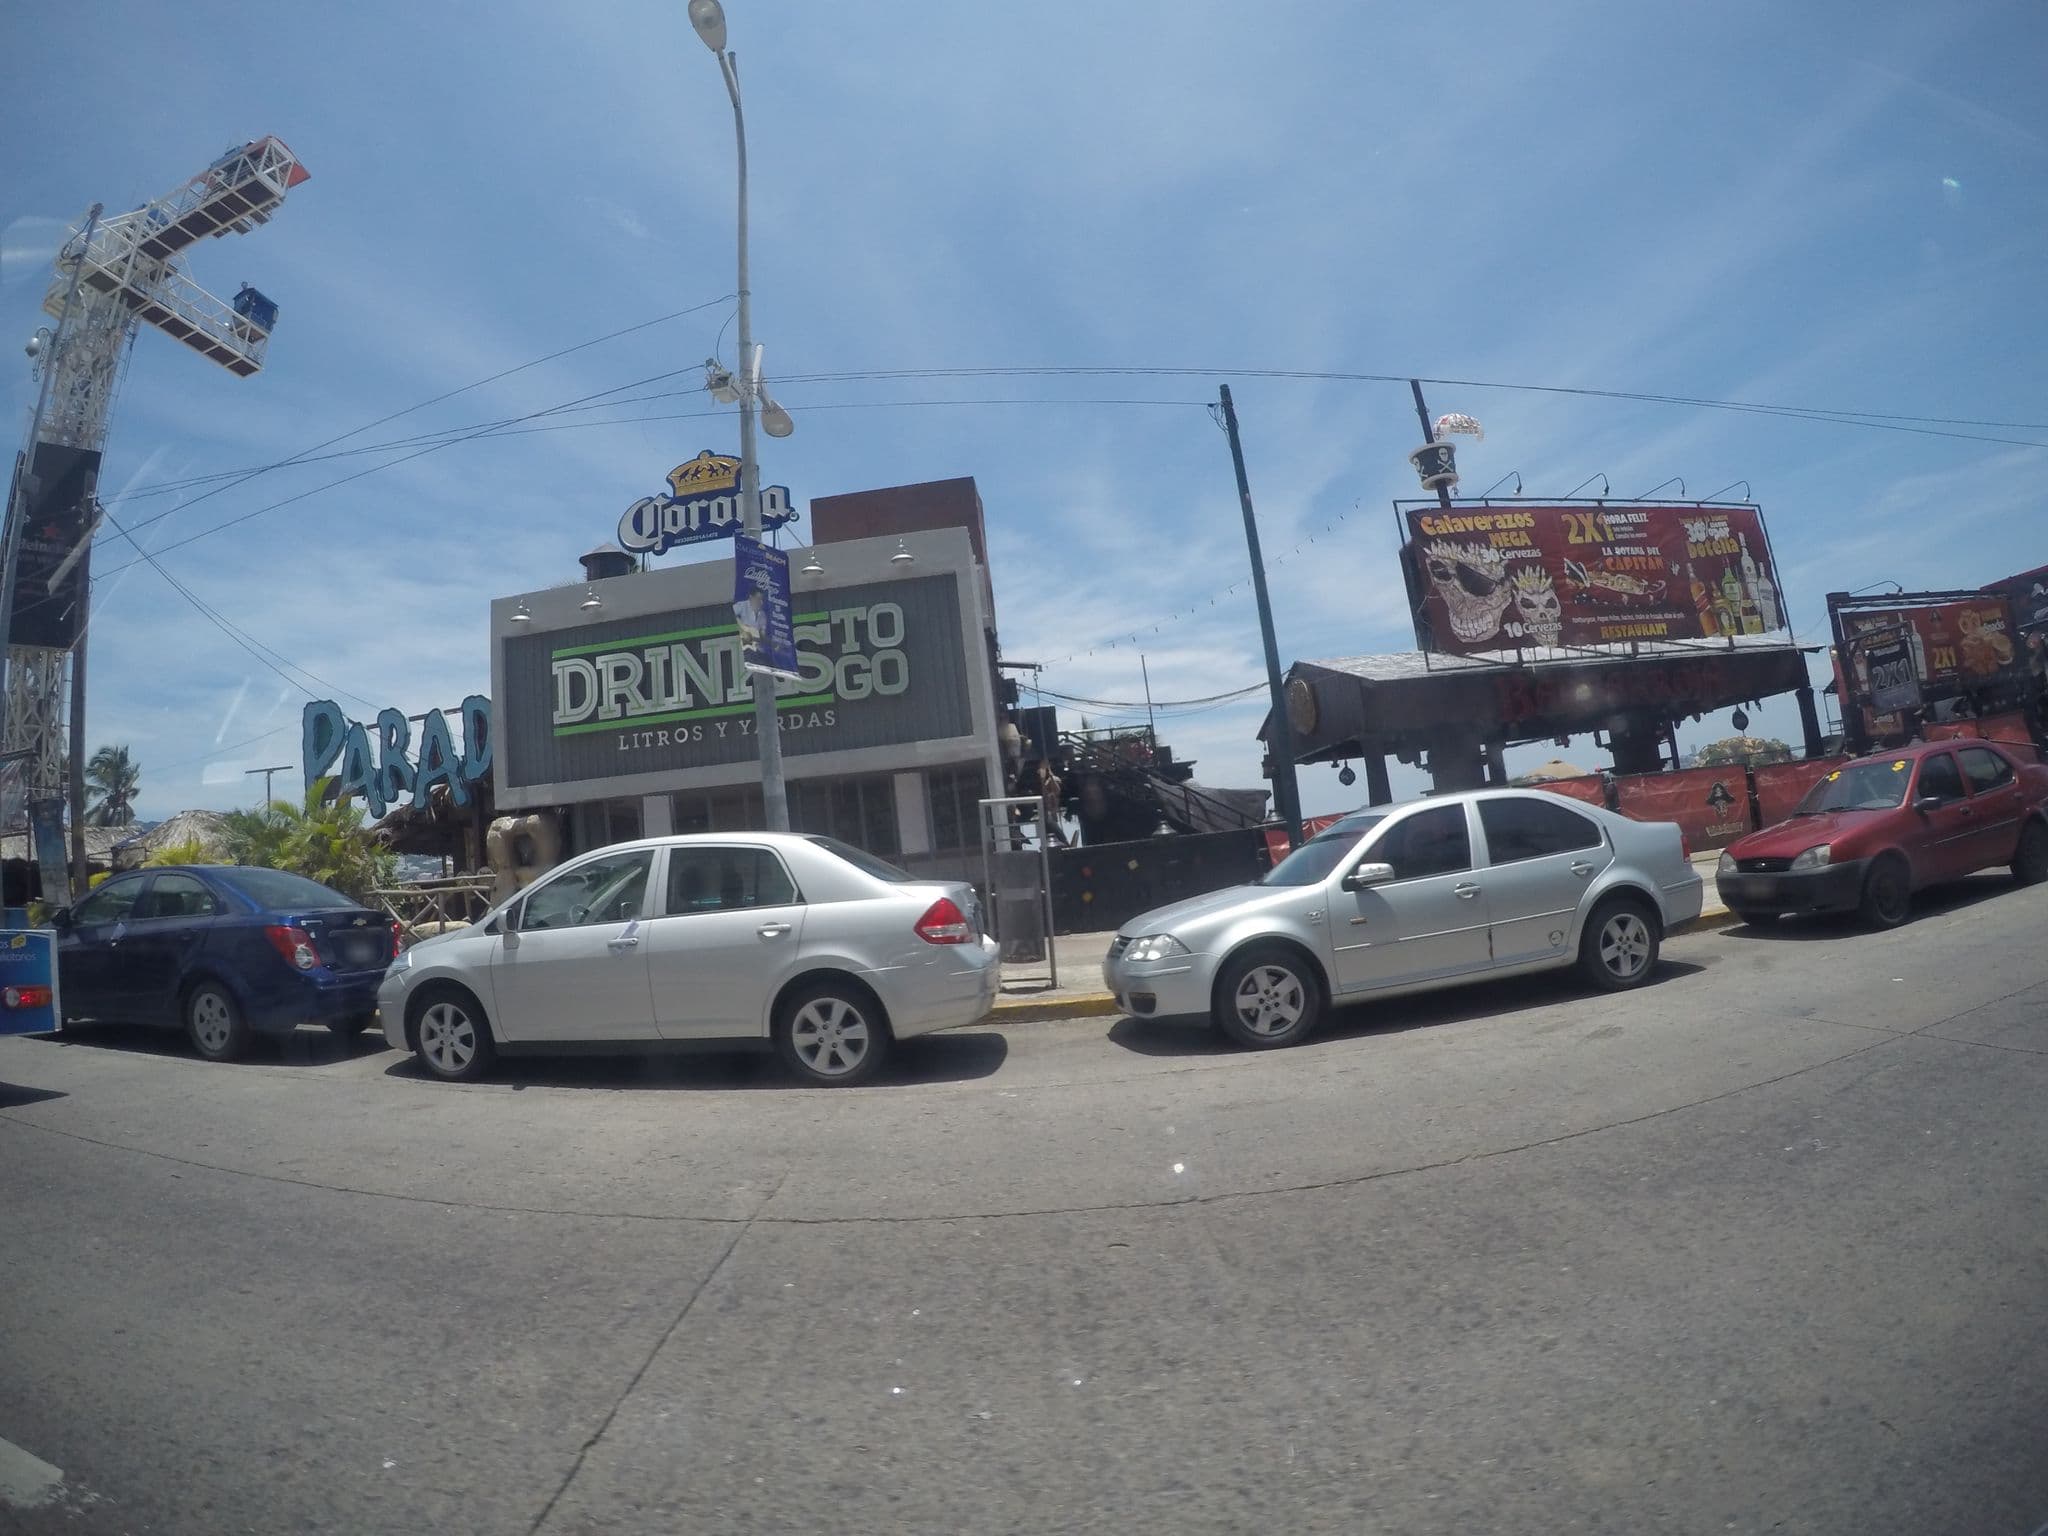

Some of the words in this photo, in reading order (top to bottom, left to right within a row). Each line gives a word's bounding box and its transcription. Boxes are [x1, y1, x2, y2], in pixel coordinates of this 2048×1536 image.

[1420, 512, 1536, 536] Calaverazos
[1603, 514, 1629, 525] HORA
[1629, 512, 1649, 523] FELIZ
[1488, 530, 1533, 547] MEGA
[1480, 548, 1500, 563] 30
[1500, 548, 1542, 559] Cervezas
[1601, 547, 1613, 556] LA
[1646, 546, 1661, 555] DEL
[831, 602, 905, 653] TO
[1503, 621, 1523, 638] 10
[1523, 622, 1562, 633] Cervezas
[1600, 623, 1668, 639] RESTAURANT
[835, 648, 910, 700] GO
[619, 725, 702, 750] LITROS
[715, 722, 728, 737] Y
[738, 710, 836, 735] YRDAS
